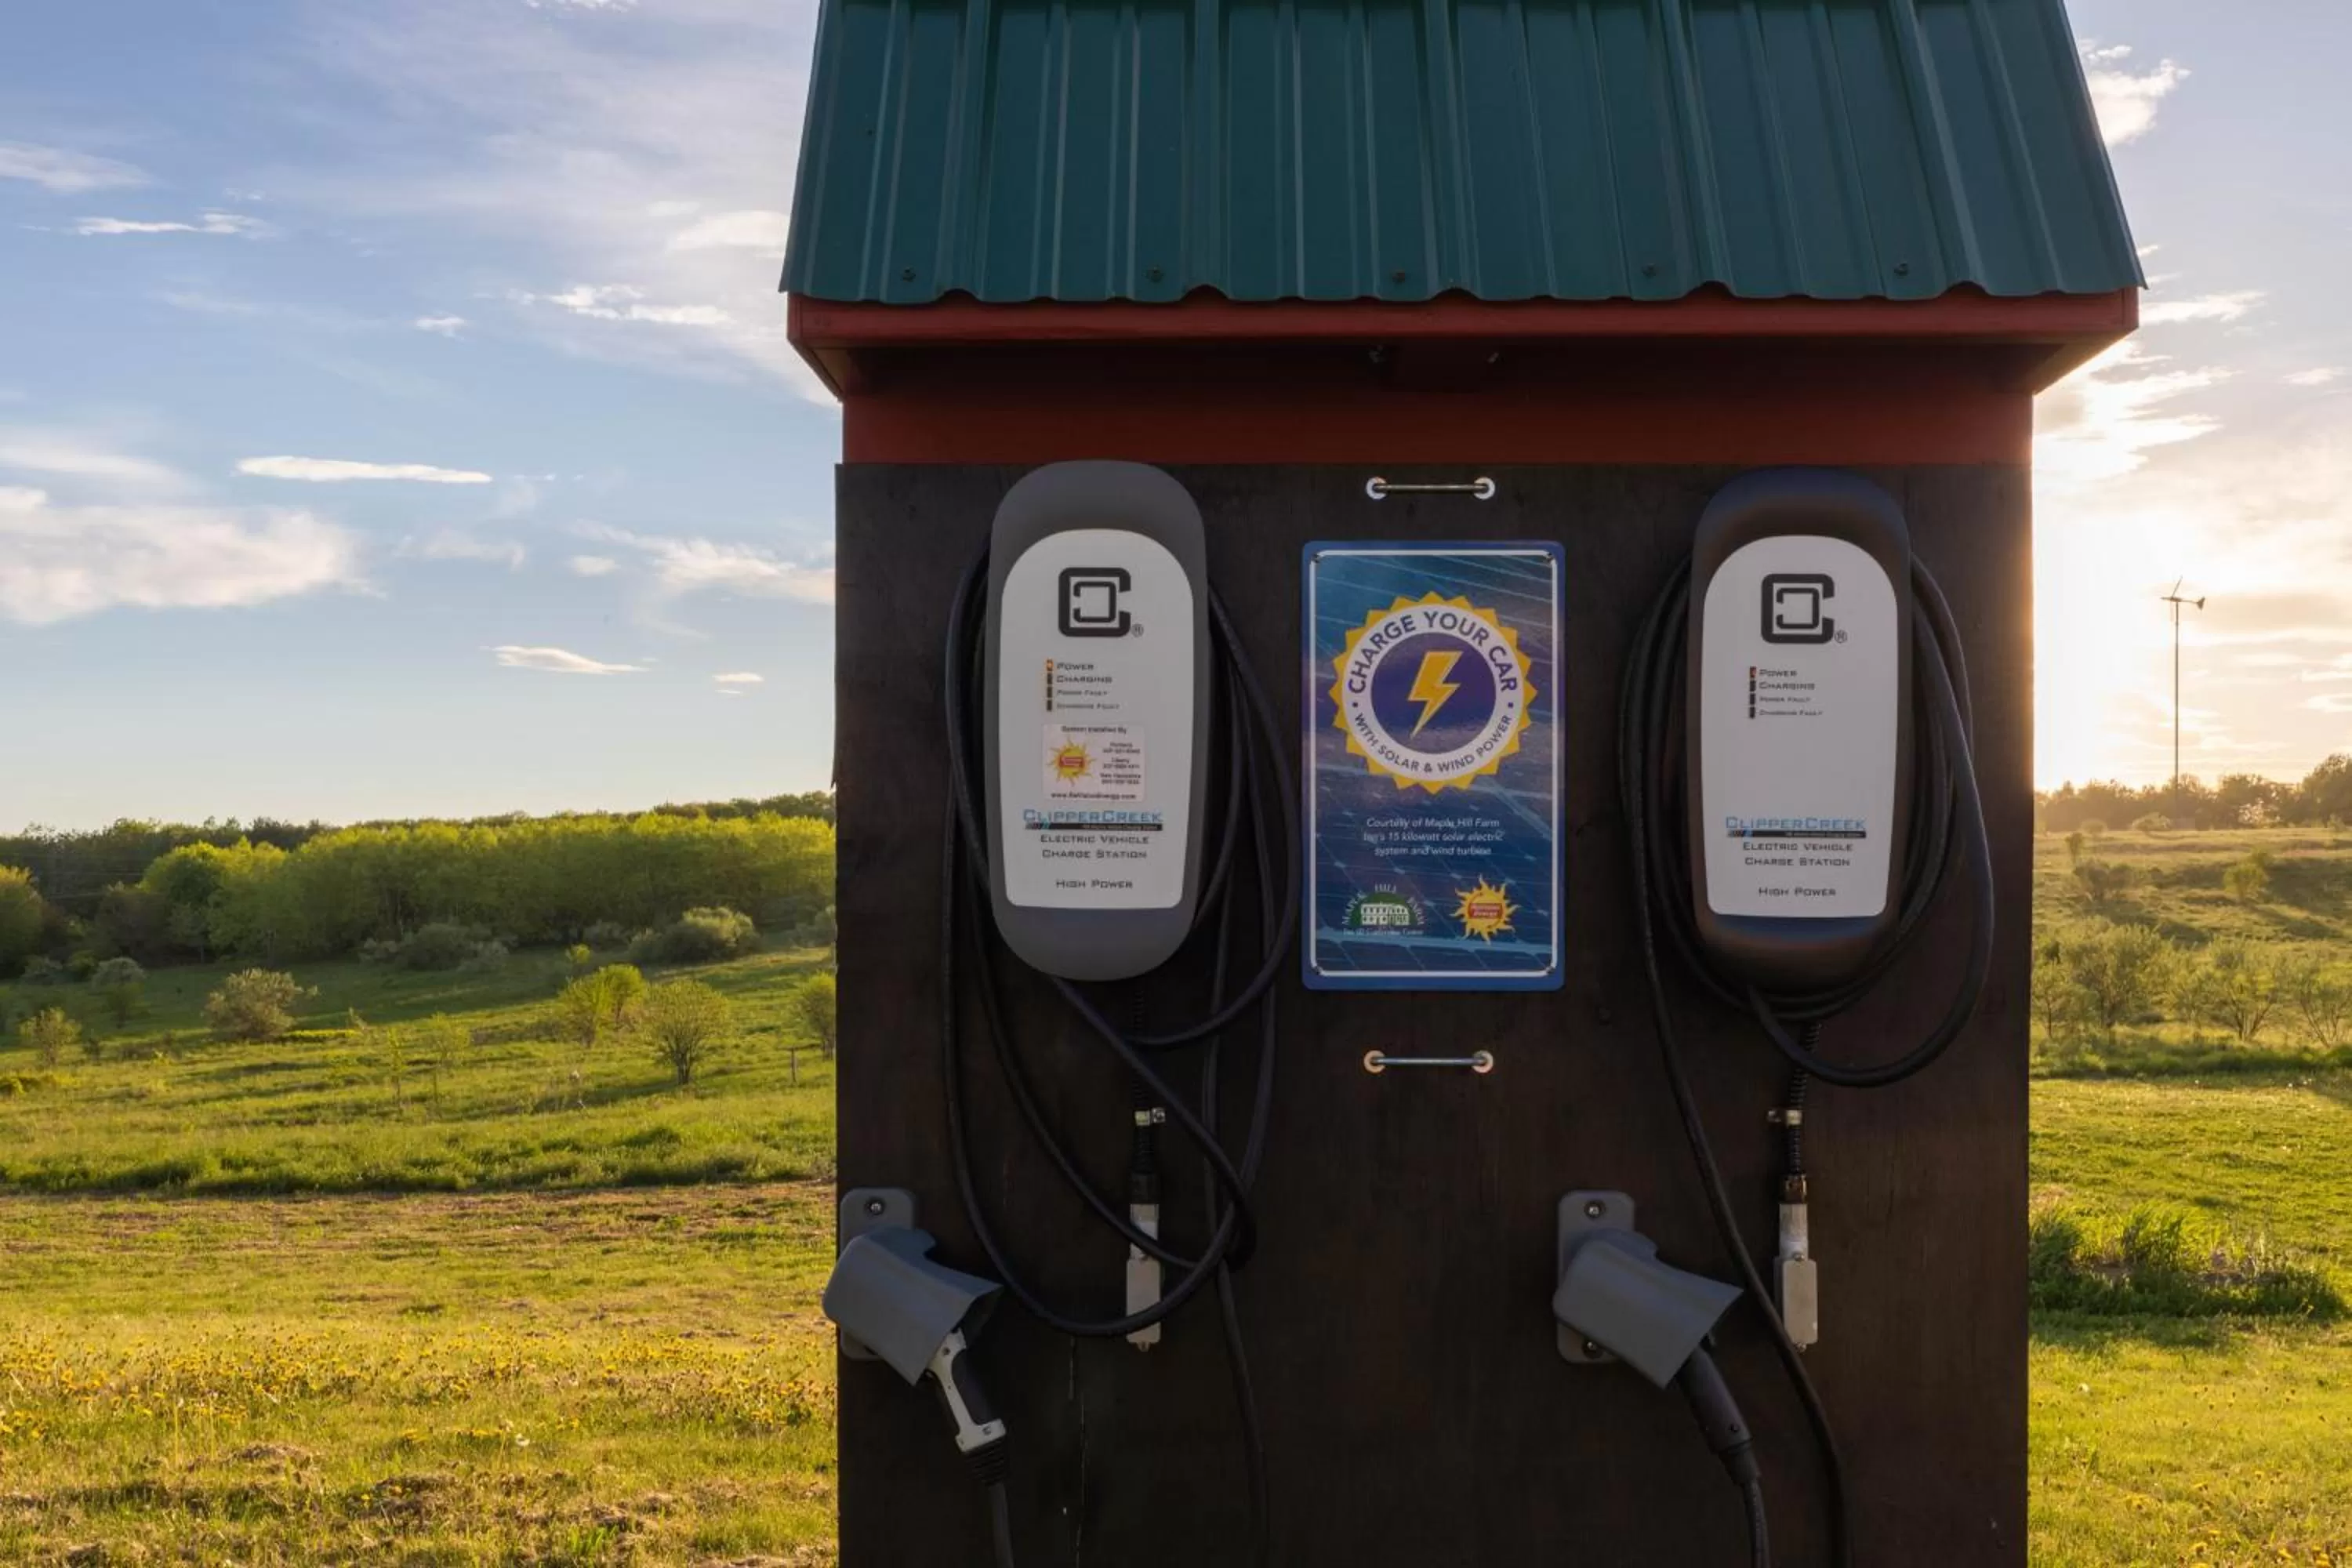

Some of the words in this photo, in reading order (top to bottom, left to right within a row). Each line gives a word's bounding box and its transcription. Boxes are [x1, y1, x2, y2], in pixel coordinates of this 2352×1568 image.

[1348, 614, 1416, 694] CHARGE
[1423, 611, 1490, 646] YOUR
[1489, 645, 1518, 692] CAR
[1759, 669, 1798, 677] POWER
[1057, 675, 1112, 684] CHARGING
[1759, 681, 1815, 690] CHARGING
[1355, 713, 1378, 747] WITH
[1377, 745, 1420, 772] SOLAR
[1424, 763, 1433, 772] &
[1437, 754, 1475, 772] WIND
[1476, 715, 1512, 757] POWER
[1411, 818, 1422, 827] of
[1457, 818, 1473, 827] Hill
[1475, 818, 1500, 827] Farm
[1040, 834, 1095, 844] ELECTRIC
[1100, 835, 1149, 844] VEHICLE
[1401, 832, 1439, 841] kilowatt
[1442, 832, 1465, 841] solar
[1743, 841, 1798, 851] ELECTRIC
[1803, 843, 1853, 851] VEHICLE
[1042, 849, 1091, 858] CHARGE
[1096, 850, 1147, 859] STATION
[1374, 846, 1409, 857] system
[1410, 845, 1428, 855] and
[1431, 846, 1455, 855] wind
[1744, 857, 1794, 866] CHARGE
[1799, 857, 1850, 866] STATION
[1056, 880, 1086, 888] HIGH
[1091, 880, 1134, 888] POWER
[1759, 887, 1789, 897] HIGH
[1795, 888, 1836, 897] POWER
